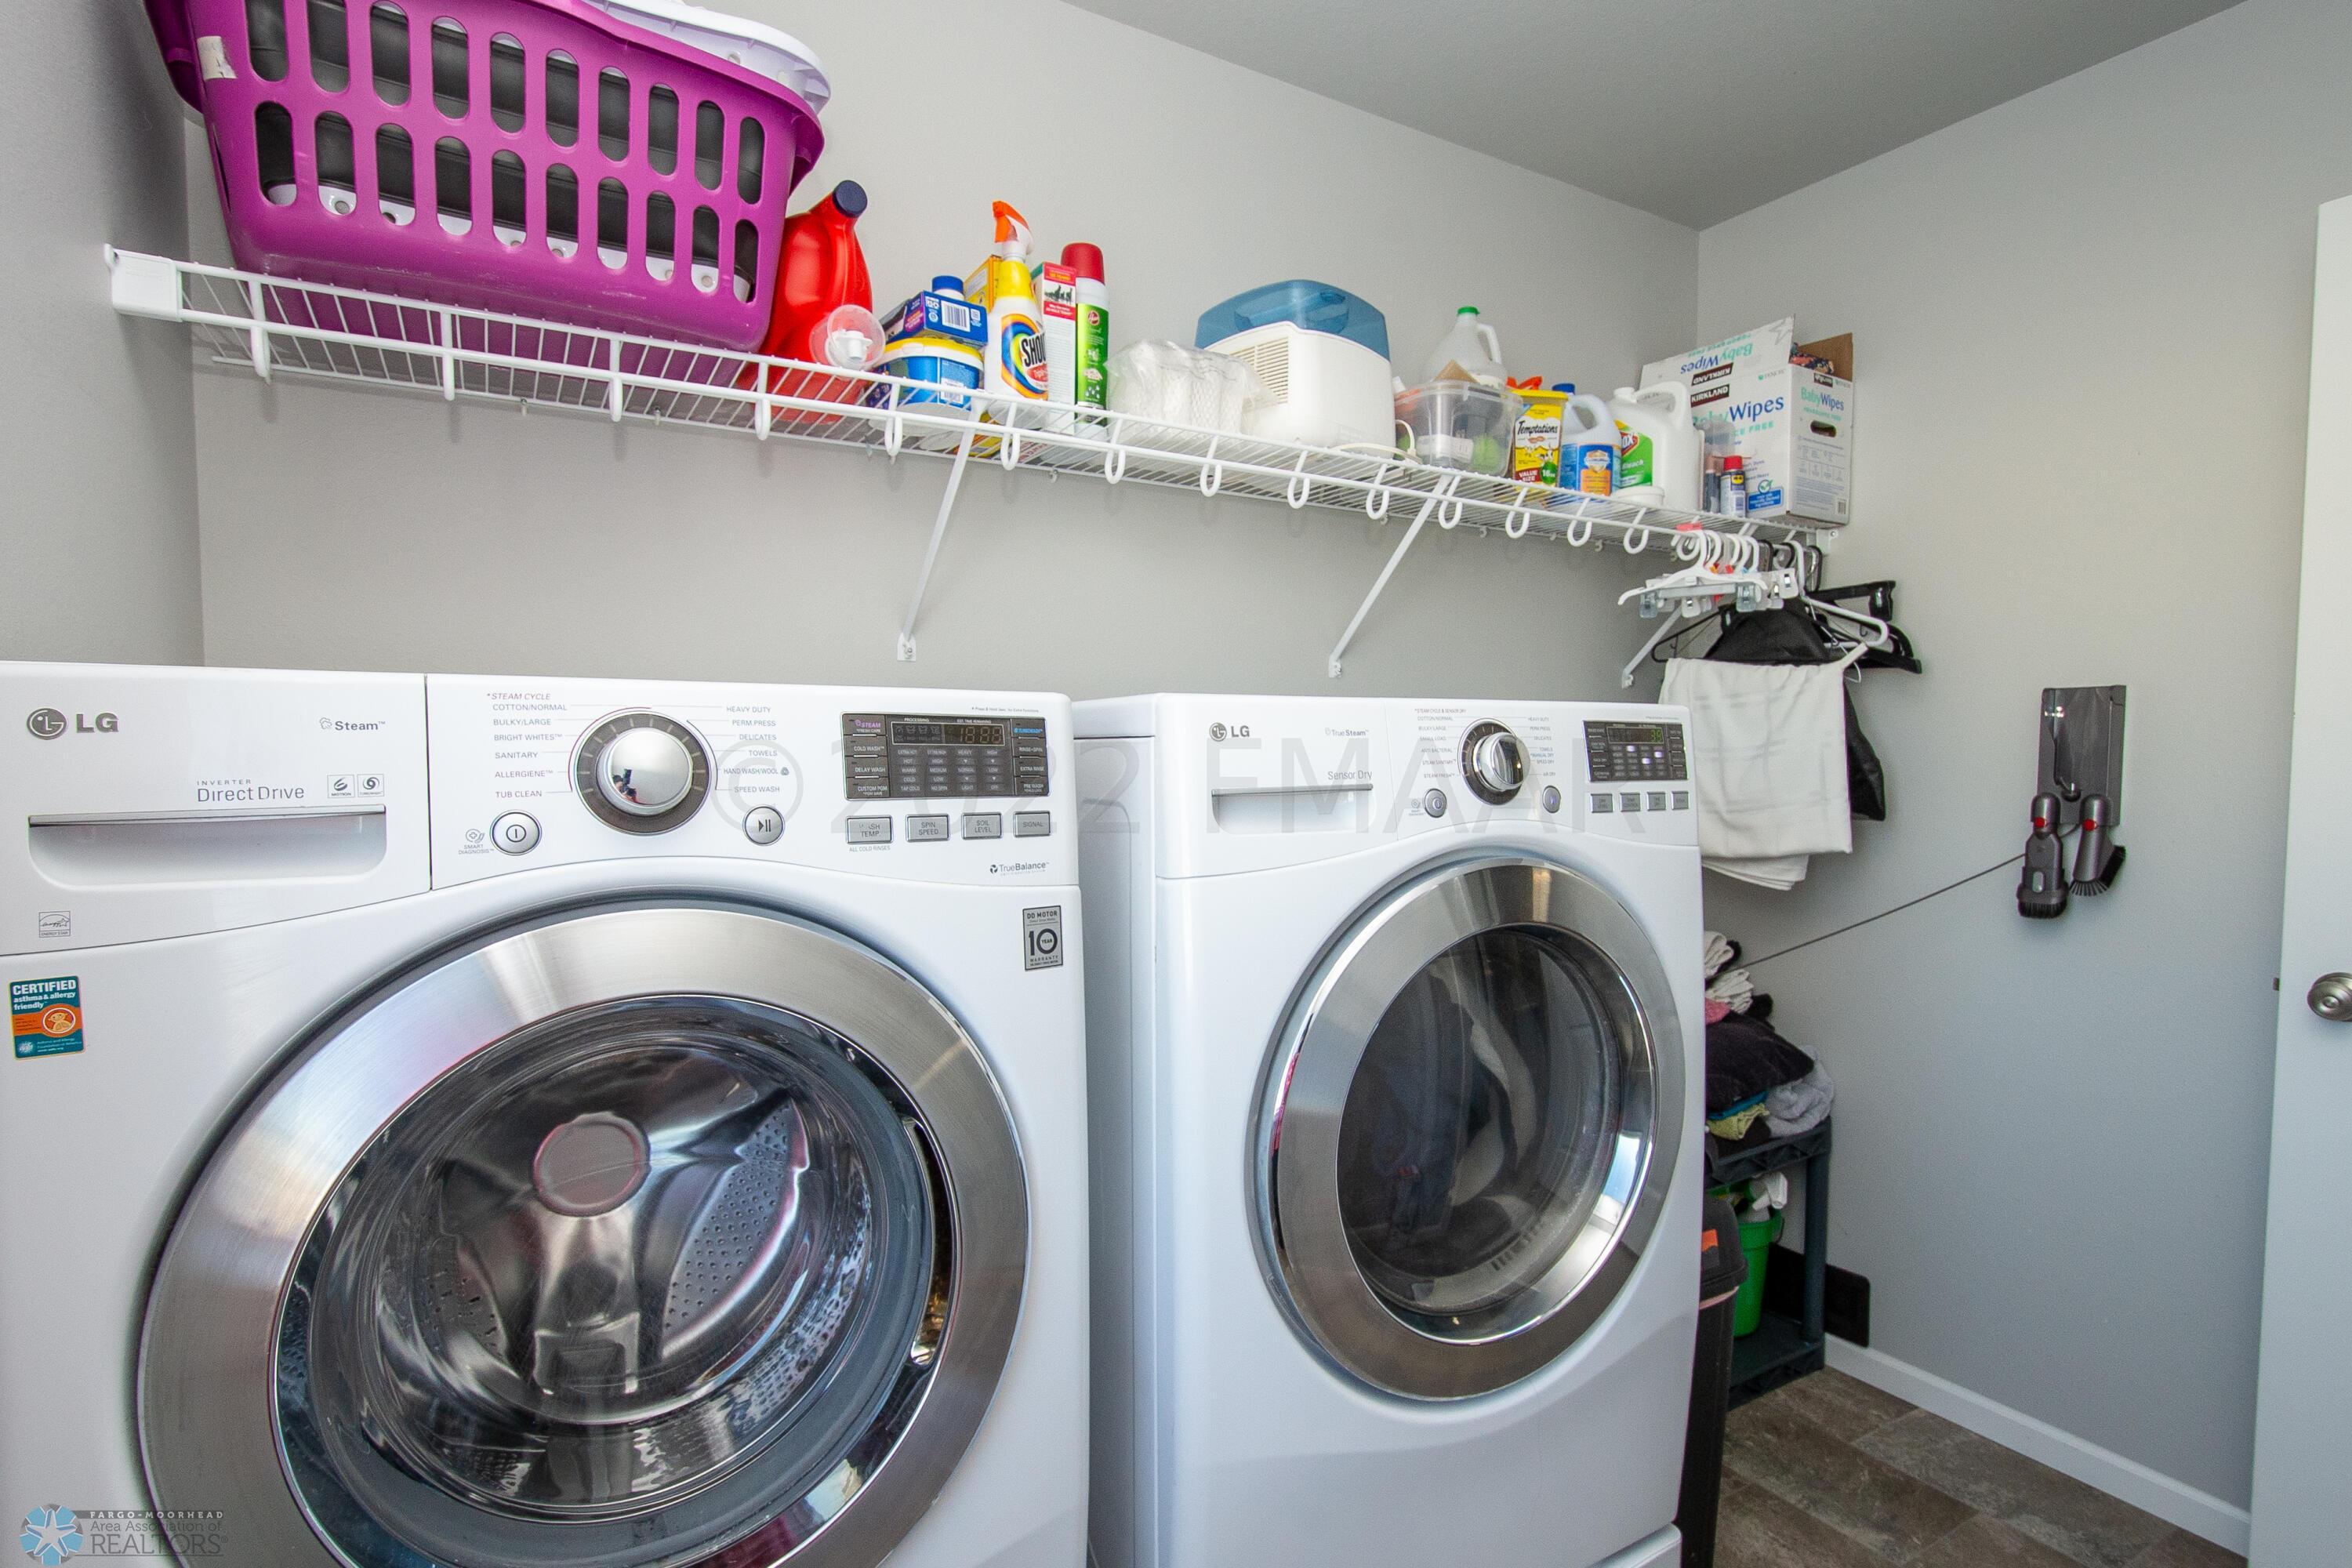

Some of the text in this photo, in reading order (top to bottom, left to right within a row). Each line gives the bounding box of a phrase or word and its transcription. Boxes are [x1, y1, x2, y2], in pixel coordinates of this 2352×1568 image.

[1021, 333, 1046, 367] SHOU
[1680, 355, 1719, 374] Wipes
[1693, 367, 1731, 383] KIRKLAND
[1691, 387, 1729, 402] KIRKLAND
[1729, 397, 1784, 422] Wipes
[1517, 420, 1558, 436] Temptations
[76, 713, 119, 734] LG
[1231, 725, 1250, 738] LG
[1328, 770, 1373, 781] Sensor Dry
[197, 786, 305, 802] Direct Drive
[1029, 928, 1058, 956] 10
[13, 979, 77, 996] CERTIFIED
[13, 994, 43, 1003] asthma
